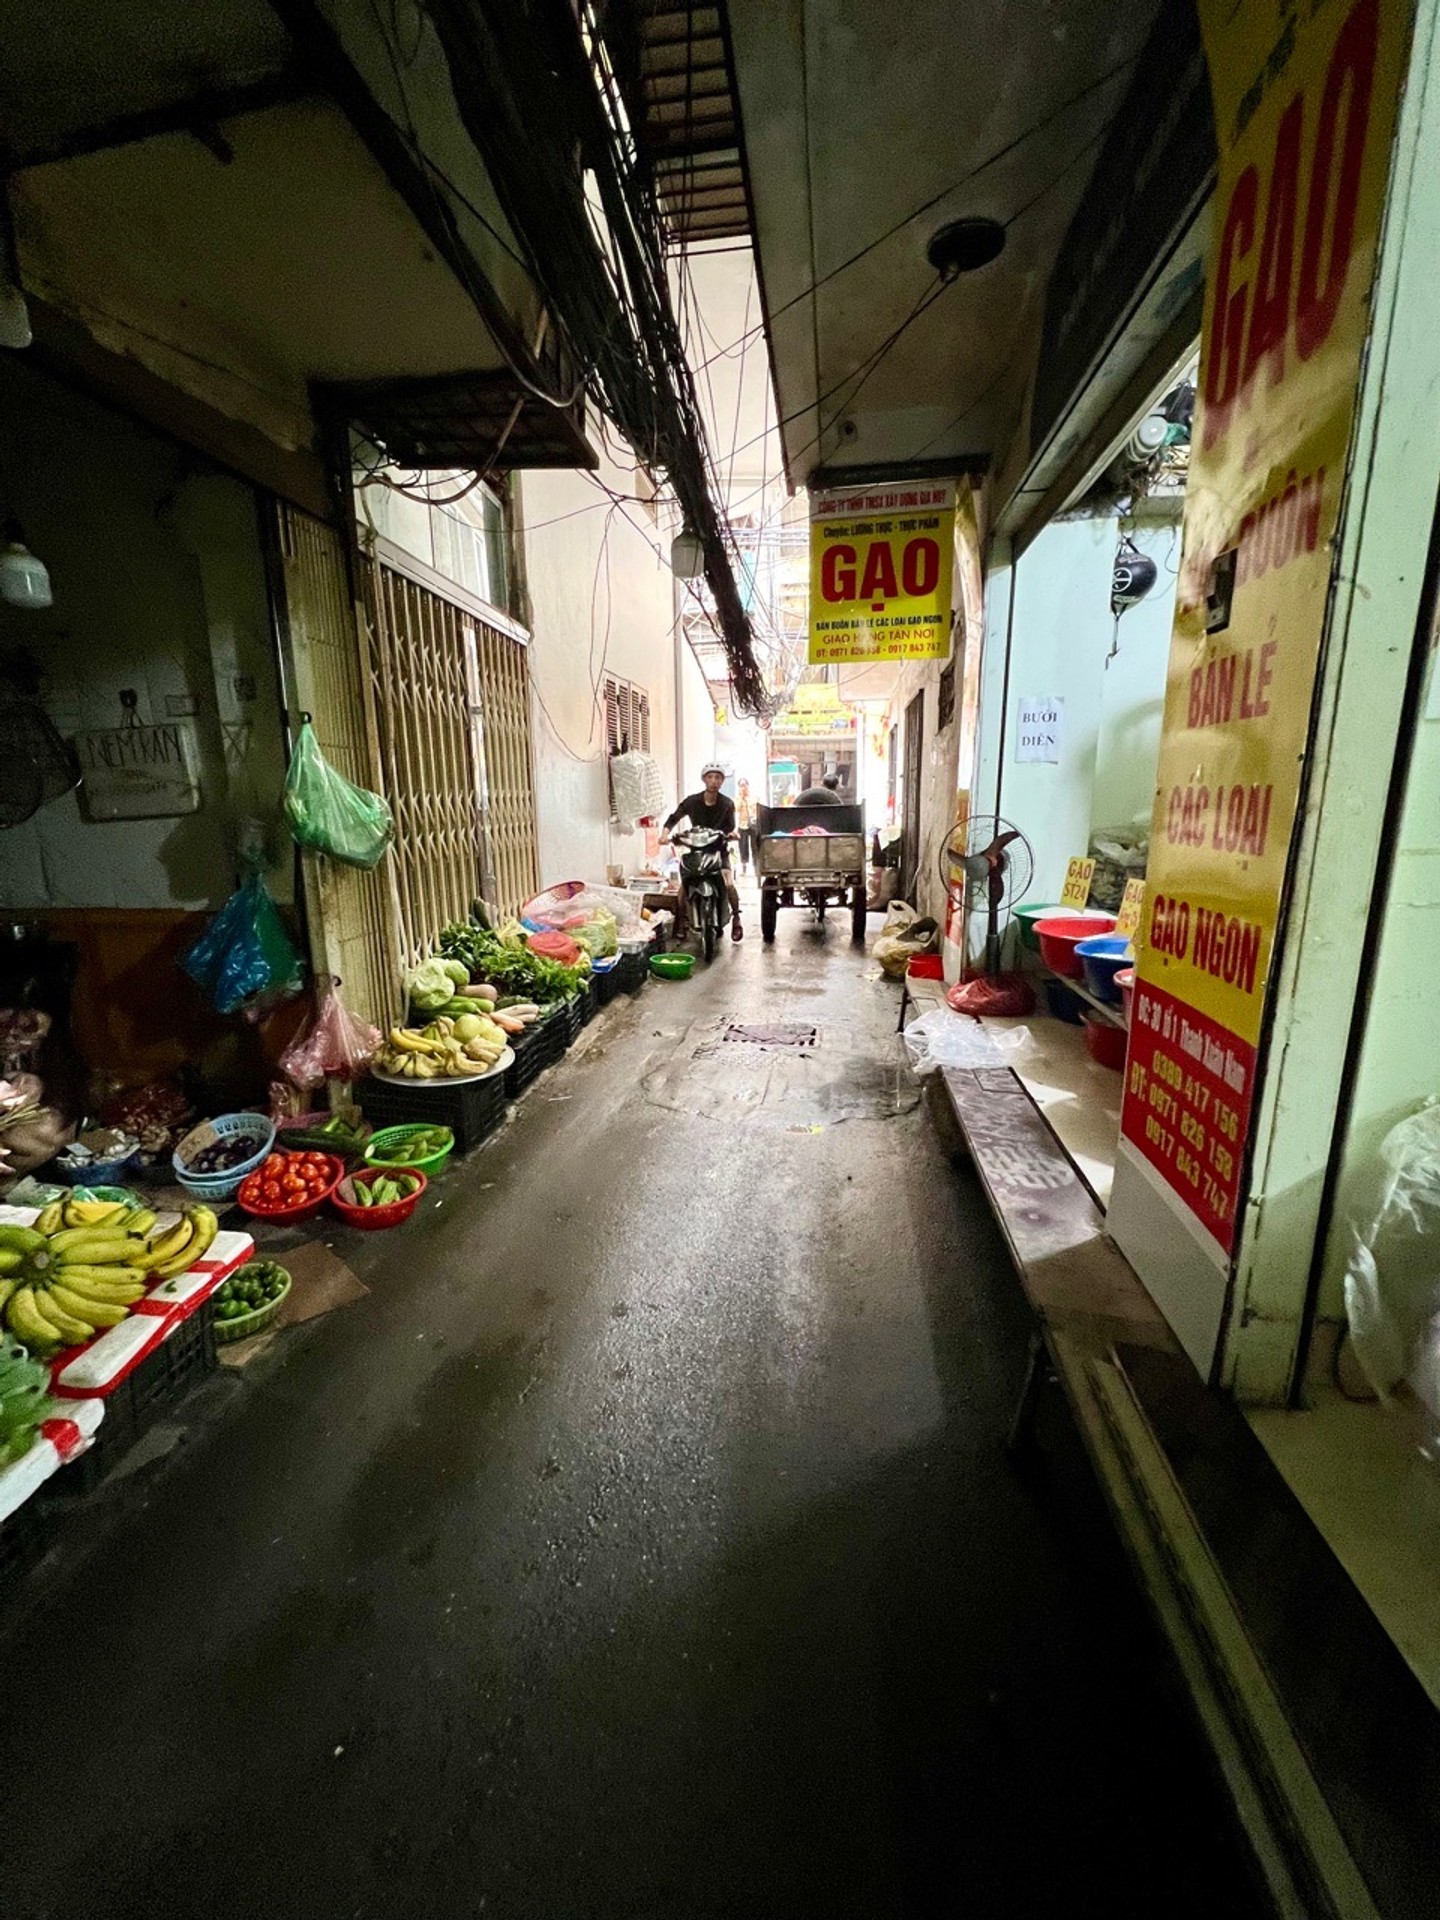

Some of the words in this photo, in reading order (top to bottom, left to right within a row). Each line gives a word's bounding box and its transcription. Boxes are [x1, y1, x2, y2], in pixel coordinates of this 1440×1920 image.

[822, 537, 939, 612] GẠO
[823, 633, 850, 645] GIAO
[1187, 645, 1236, 729] BÁN
[1239, 612, 1277, 721] LẺ
[1167, 772, 1210, 849] CÁC
[1212, 784, 1274, 871] LOẠI
[1150, 894, 1190, 966] GẠO
[1192, 906, 1262, 994] NGON
[1146, 1114, 1175, 1158] 0917
[1176, 1145, 1201, 1188] 843
[1180, 1110, 1205, 1151] 826
